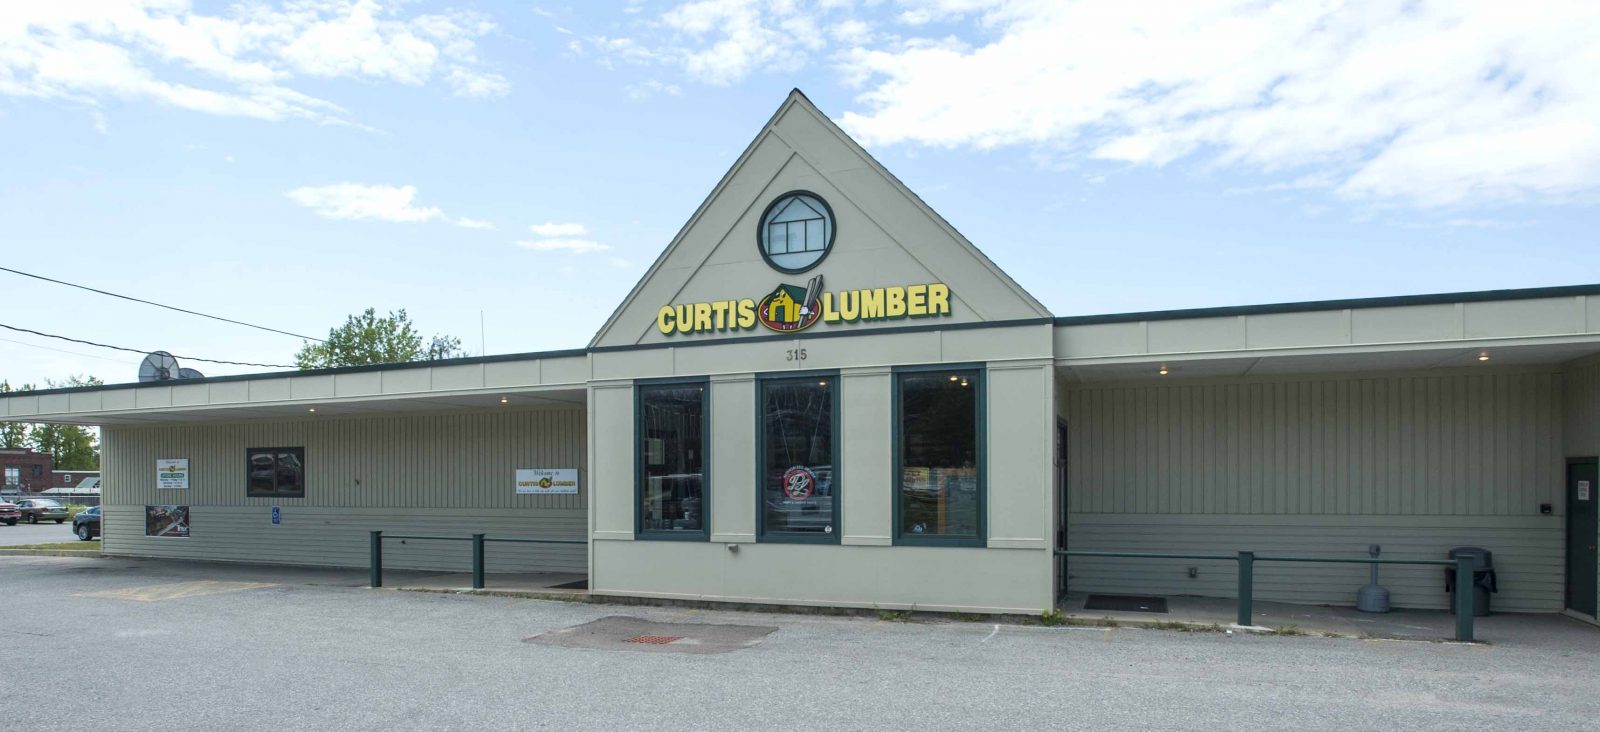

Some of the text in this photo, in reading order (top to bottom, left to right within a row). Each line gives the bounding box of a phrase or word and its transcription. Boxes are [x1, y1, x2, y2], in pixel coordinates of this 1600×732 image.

[657, 282, 952, 334] CURTIS LUMBER
[786, 349, 808, 361] 315
